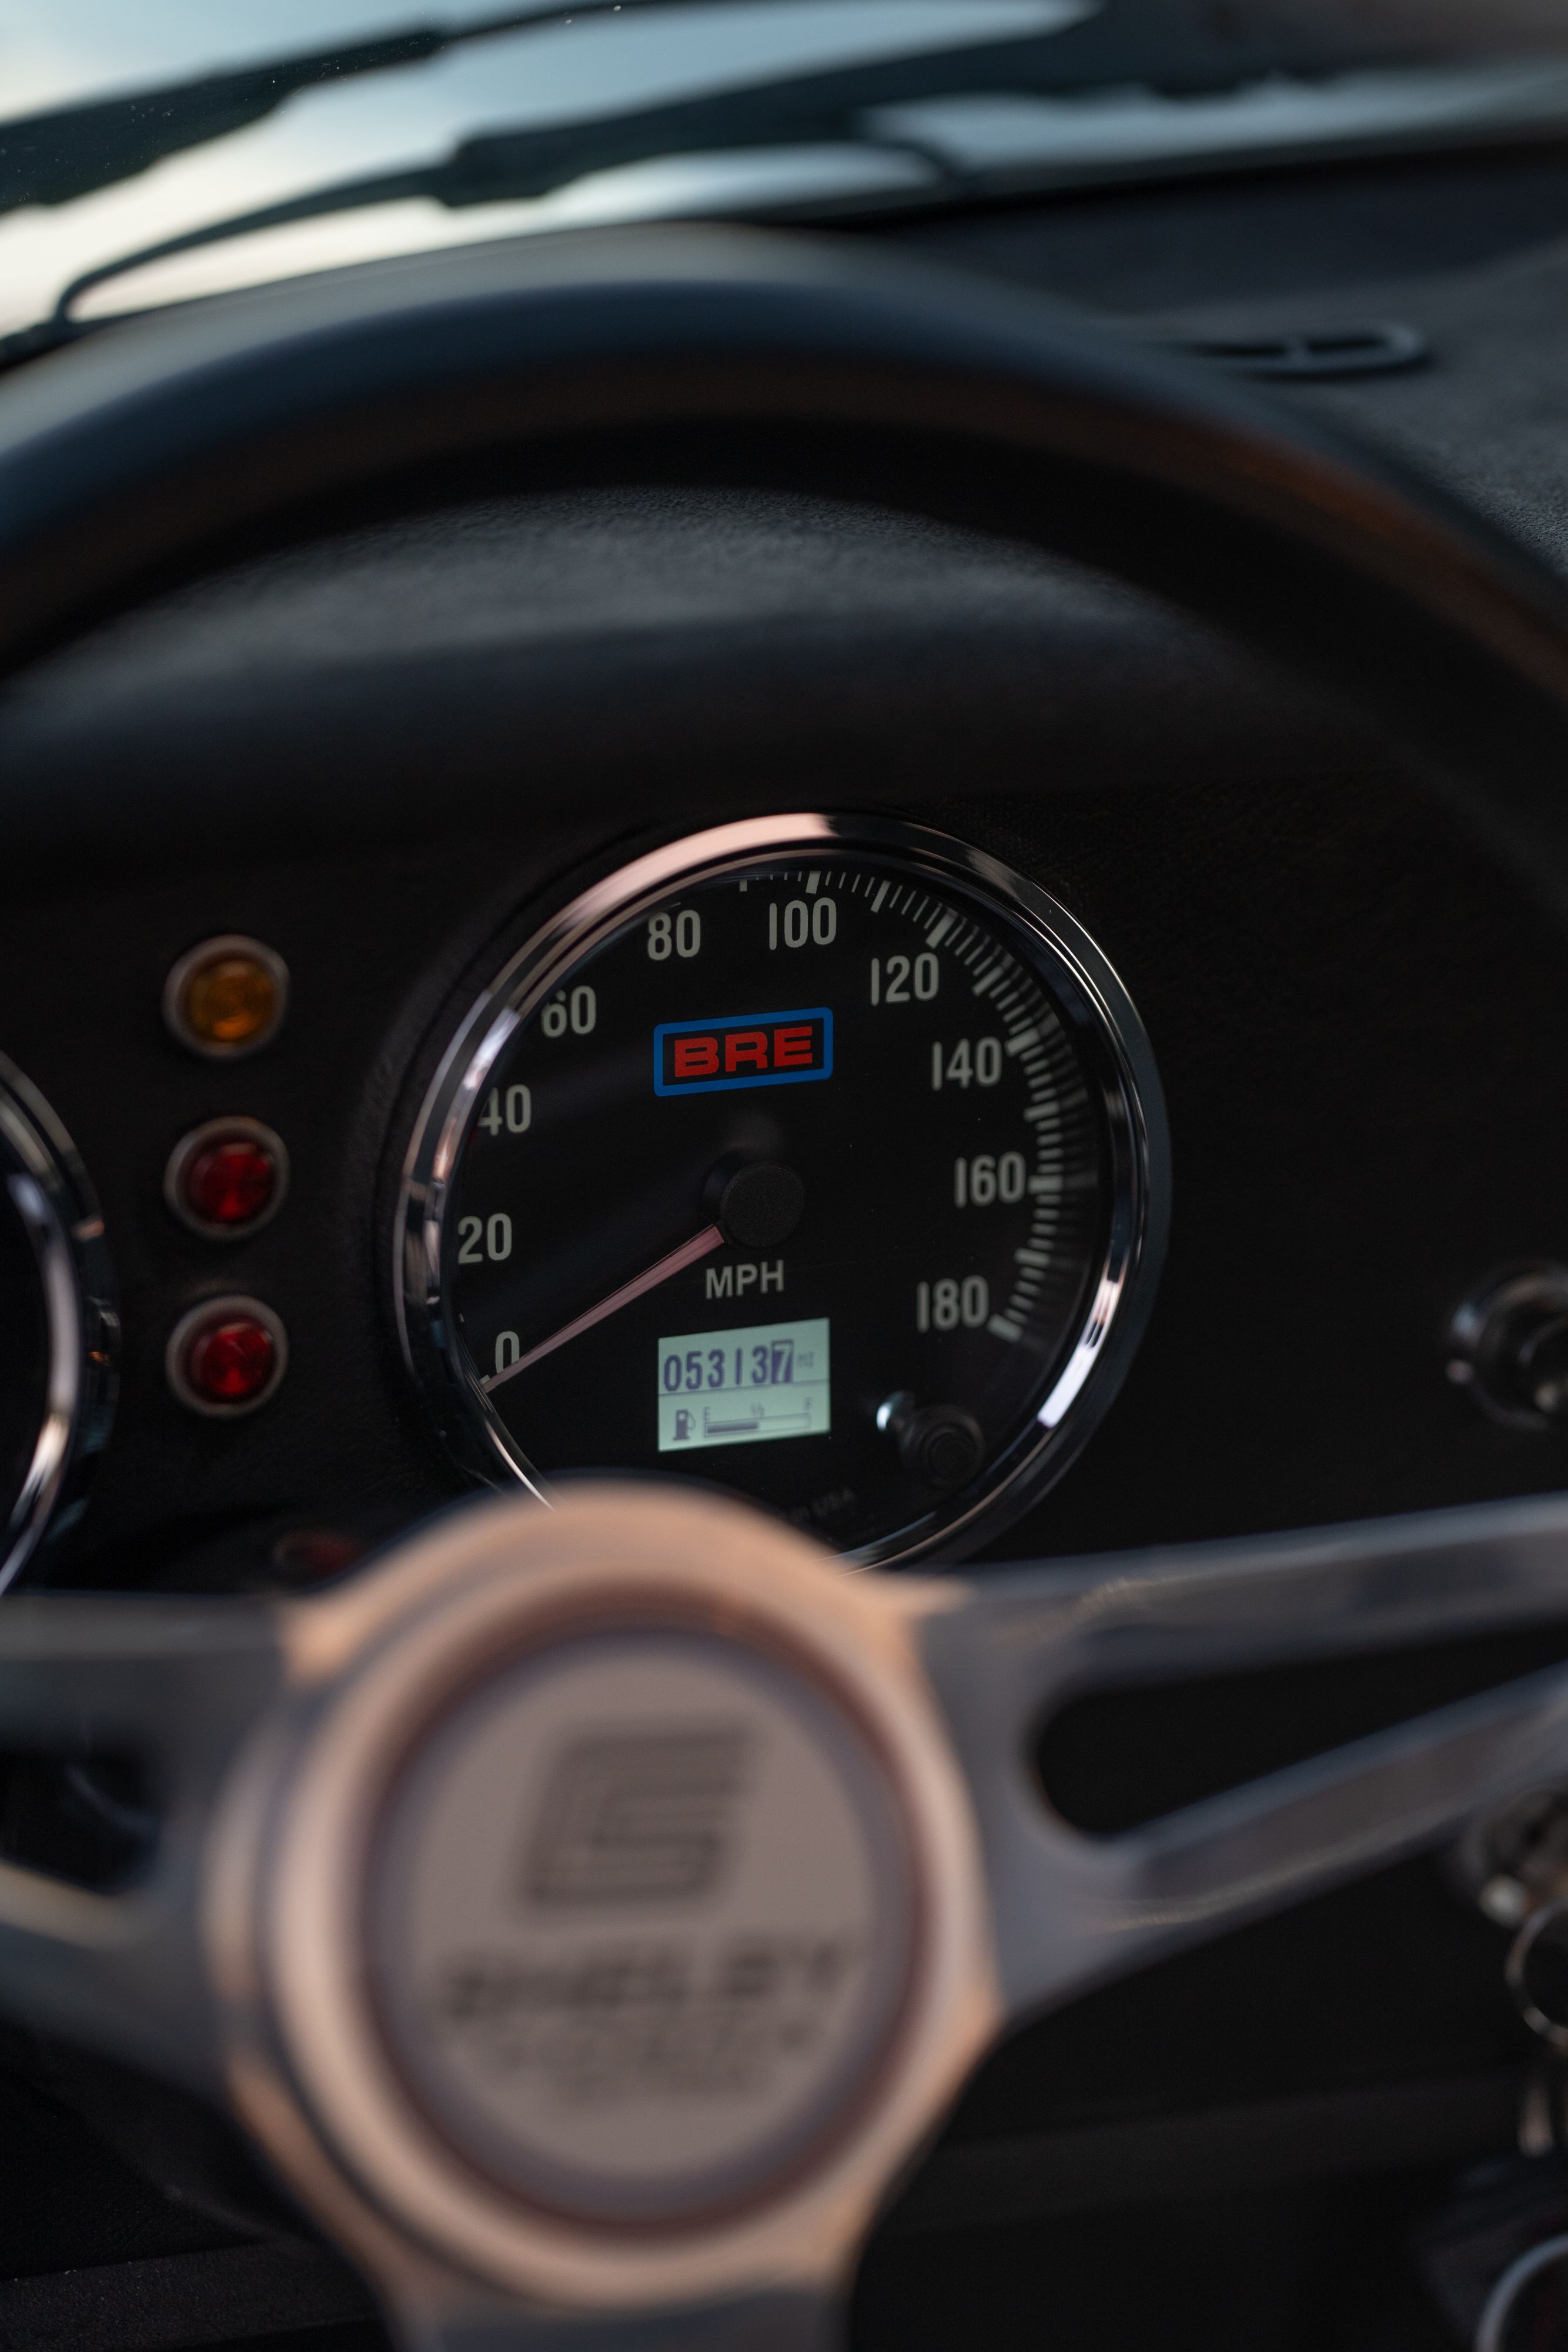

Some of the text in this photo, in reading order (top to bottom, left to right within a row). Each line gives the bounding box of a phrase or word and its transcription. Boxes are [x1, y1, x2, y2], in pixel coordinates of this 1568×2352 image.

[647, 908, 701, 961] 80
[769, 897, 837, 951] 100
[870, 952, 940, 1007] 120
[541, 985, 597, 1038] 60
[674, 1025, 813, 1077] BRE
[931, 1036, 1002, 1091] 140
[477, 1084, 531, 1137] 40
[954, 1151, 1027, 1208] 160
[457, 1212, 513, 1264] 20
[706, 1259, 784, 1300] MPH
[916, 1275, 989, 1334] 180
[495, 1331, 520, 1374] 0
[663, 1338, 793, 1391] 053137
